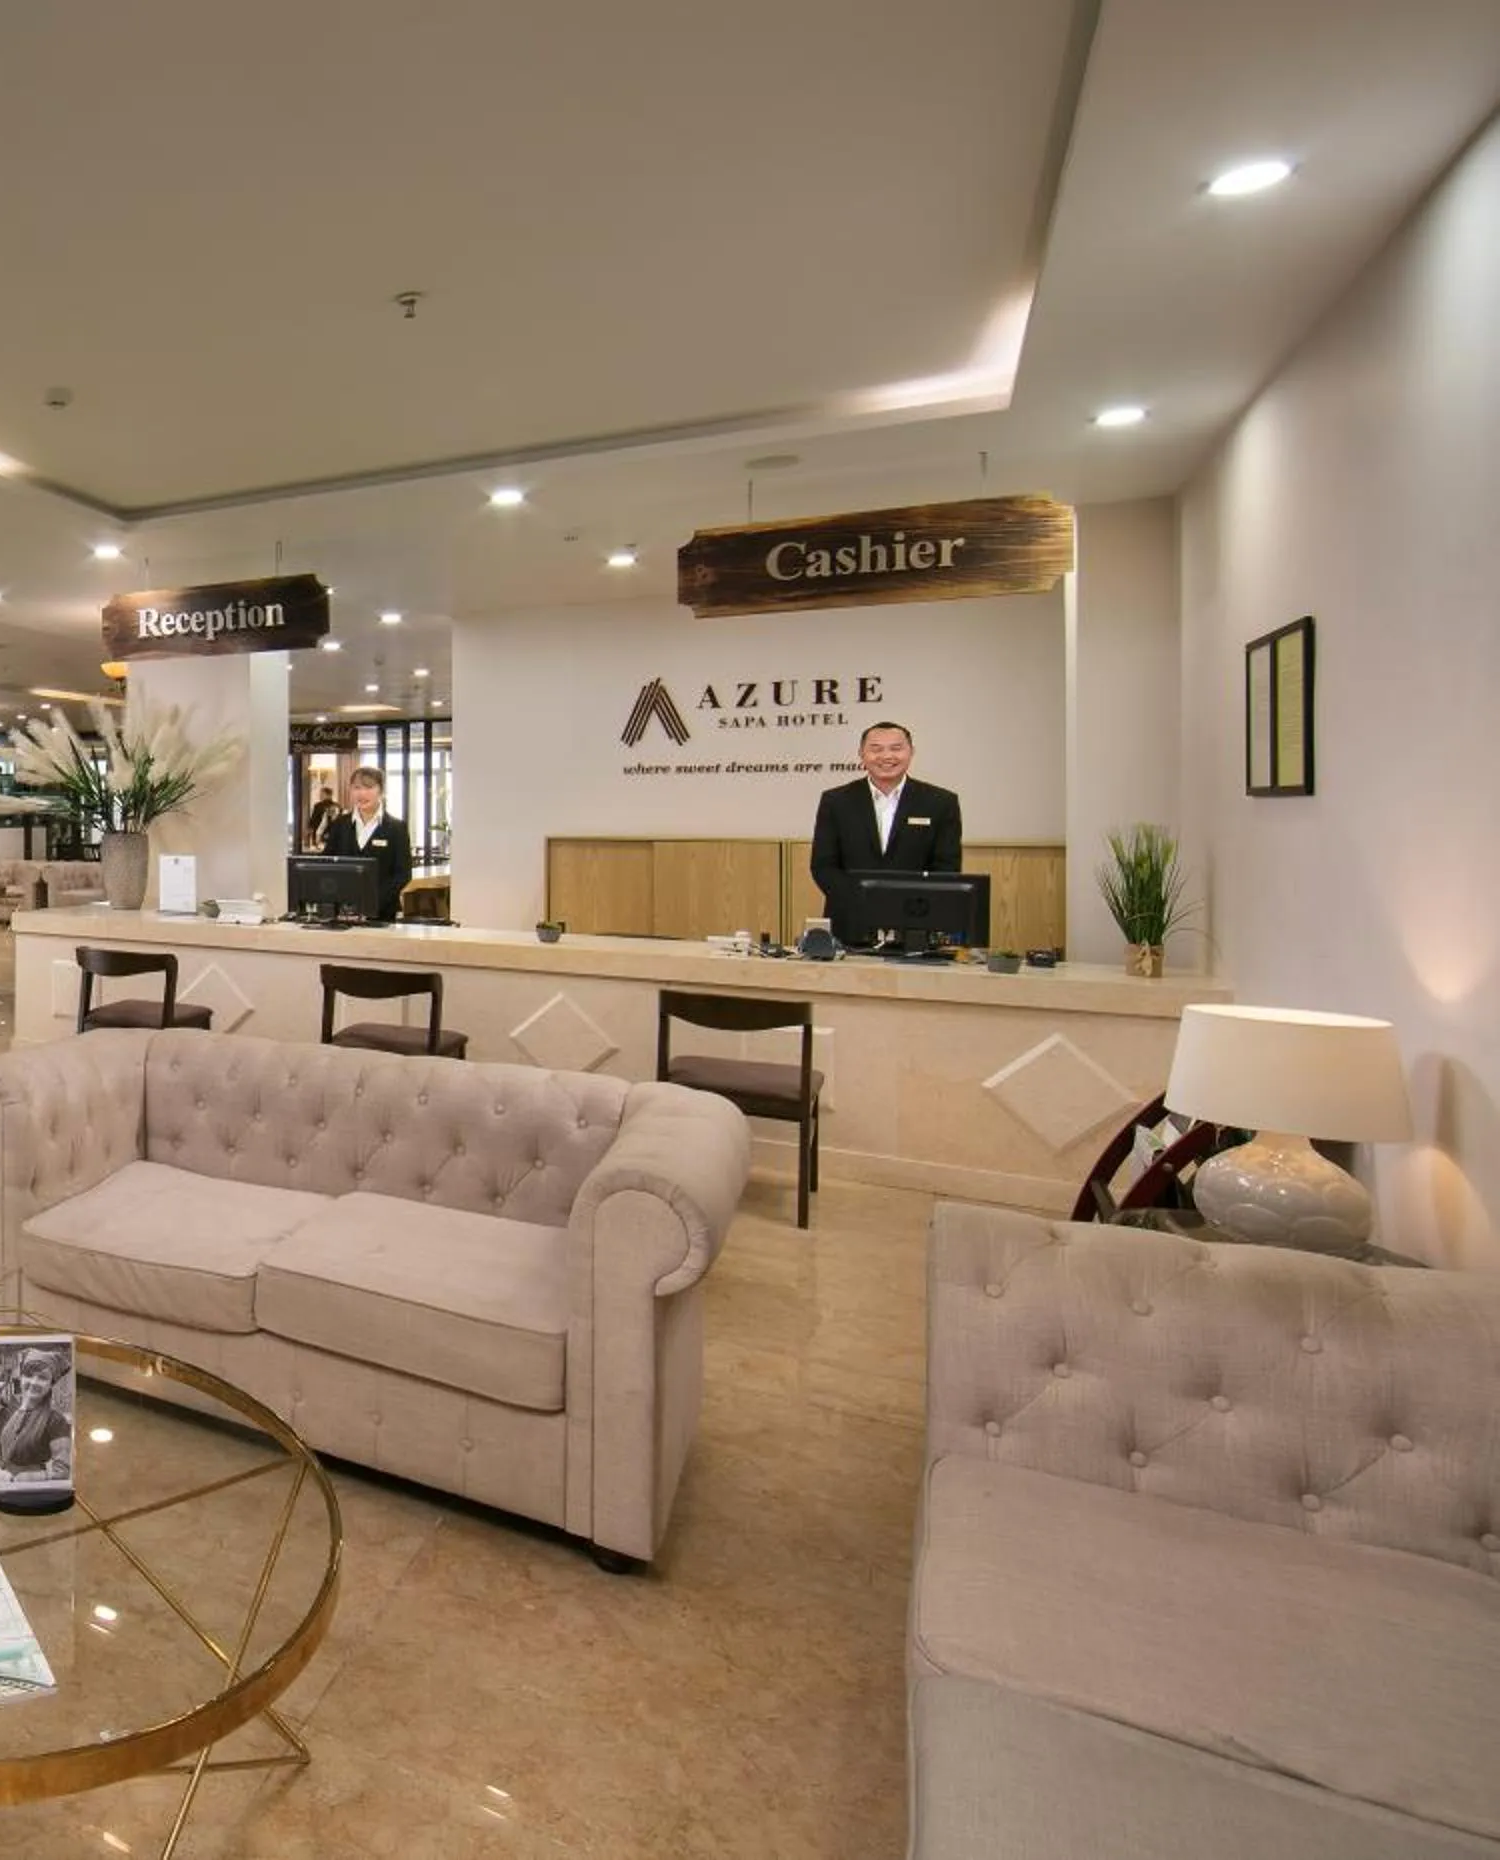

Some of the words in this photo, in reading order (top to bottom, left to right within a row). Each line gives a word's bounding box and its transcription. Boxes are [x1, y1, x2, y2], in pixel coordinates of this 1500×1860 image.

[765, 531, 966, 582] Cashier
[137, 600, 285, 641] Reception
[696, 676, 884, 709] AZURE
[718, 716, 767, 729] SAPA
[776, 713, 849, 727] HOTEL
[622, 762, 671, 776] where
[675, 762, 721, 774] sweet
[725, 761, 789, 774] dreams
[792, 762, 823, 773] are
